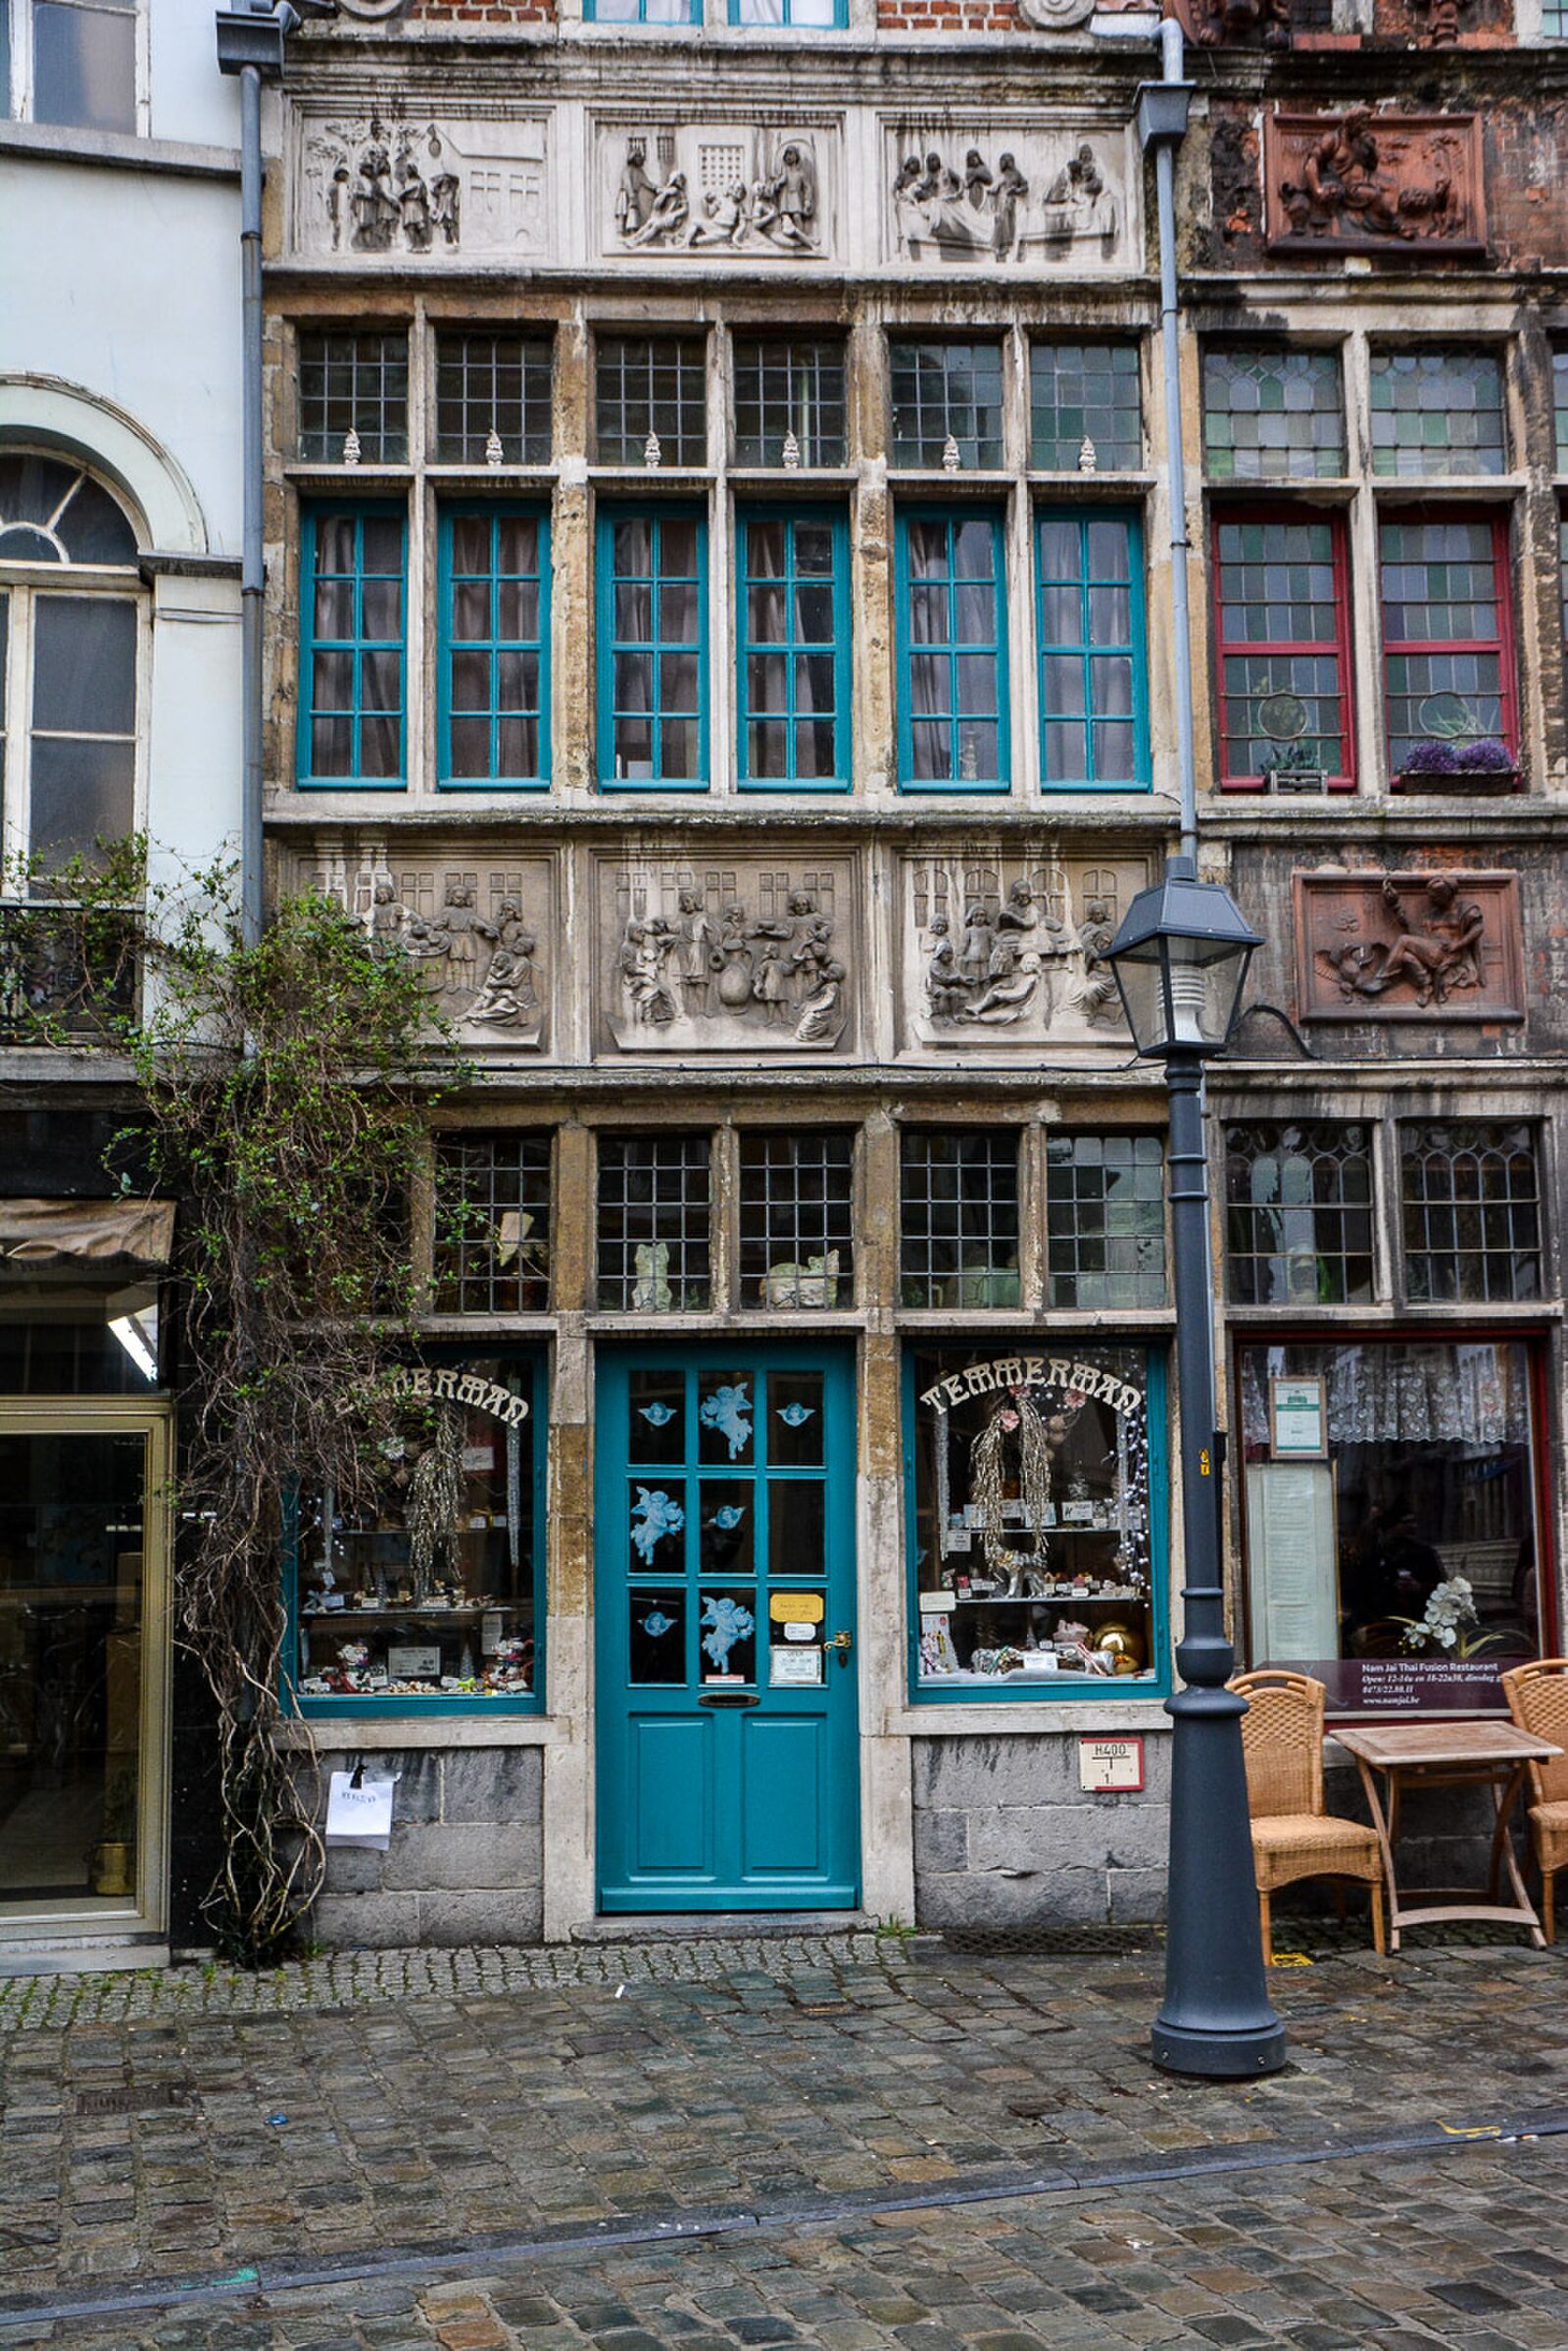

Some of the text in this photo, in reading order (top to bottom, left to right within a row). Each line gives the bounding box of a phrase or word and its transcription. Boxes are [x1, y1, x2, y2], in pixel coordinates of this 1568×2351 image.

[919, 1356, 1143, 1417] TEMMERMAN
[1386, 1663, 1396, 1672] Jai
[1398, 1663, 1418, 1672] Thai
[1362, 1675, 1385, 1685] Open:
[1095, 1744, 1126, 1755] H400
